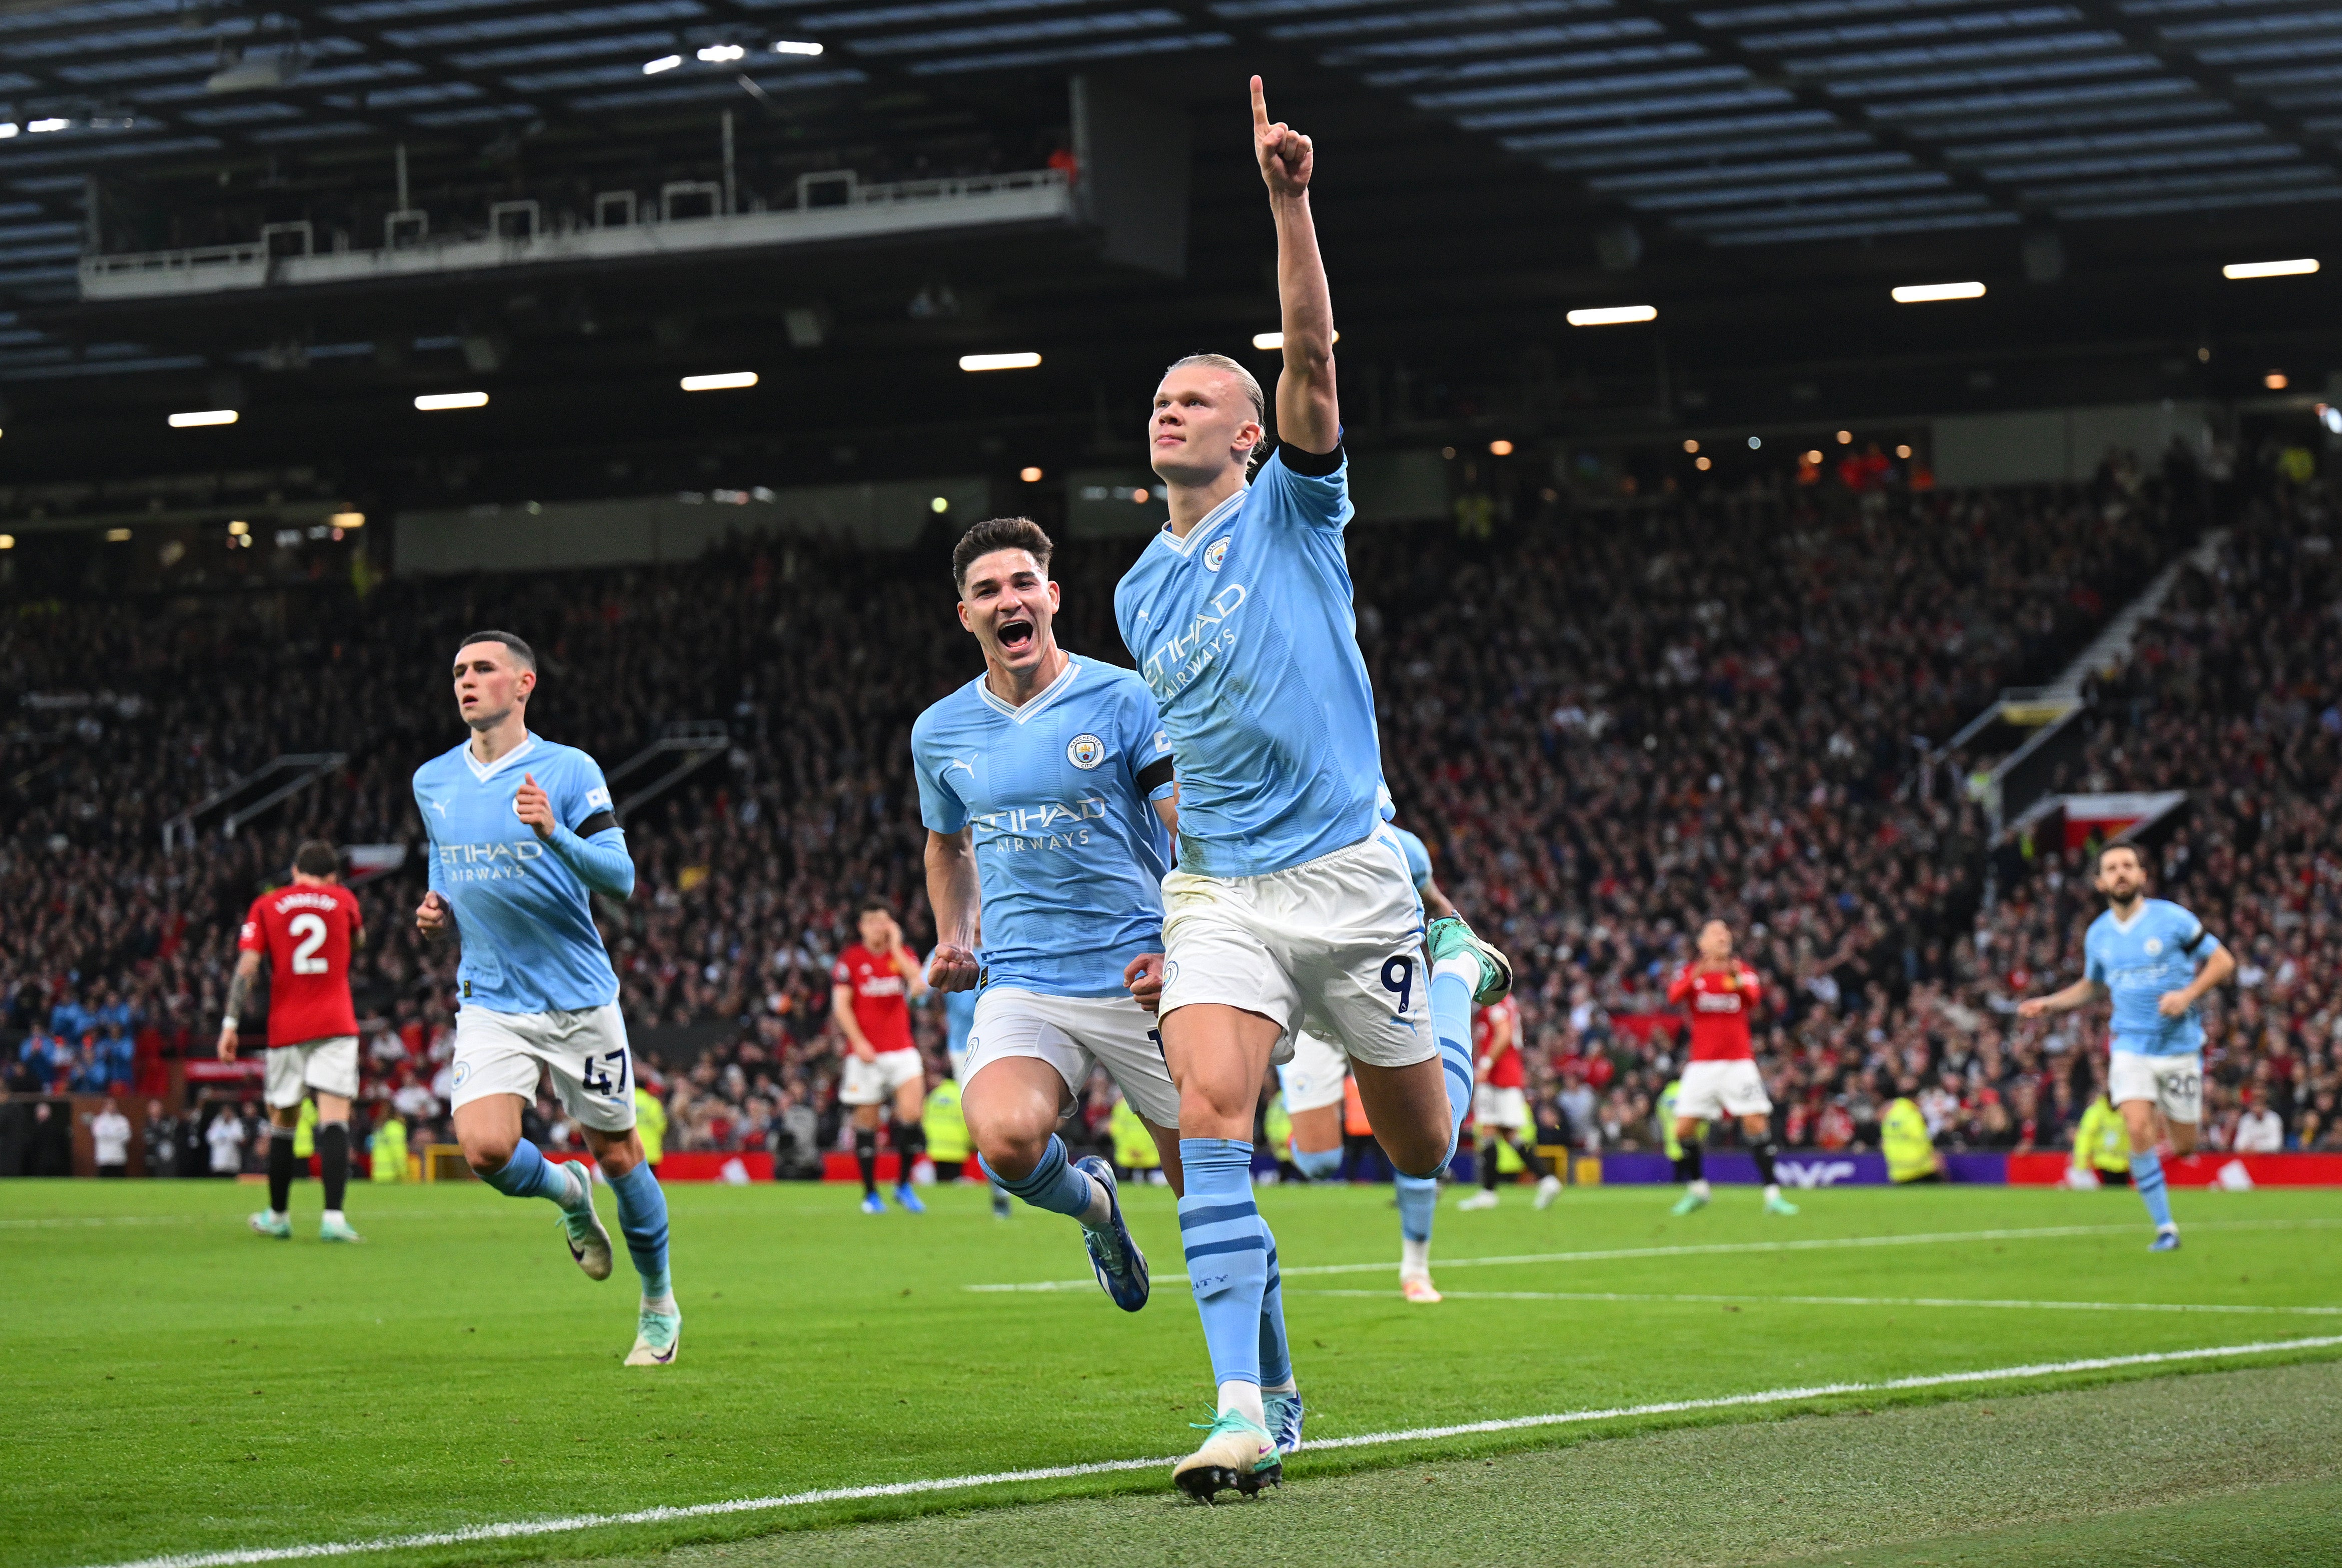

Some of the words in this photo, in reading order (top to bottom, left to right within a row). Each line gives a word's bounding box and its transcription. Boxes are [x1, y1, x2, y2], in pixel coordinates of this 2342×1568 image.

[1142, 584, 1246, 688] ETIHAD
[1165, 628, 1236, 699] AIRWAYS
[1070, 736, 1101, 748] MANCHESTER
[439, 841, 543, 865] ETIHAD
[996, 829, 1089, 852] AIRWAYS
[451, 865, 525, 882] AIRWAYS
[289, 913, 329, 975] 2
[1381, 955, 1413, 1014] 9
[582, 1047, 627, 1095] 47
